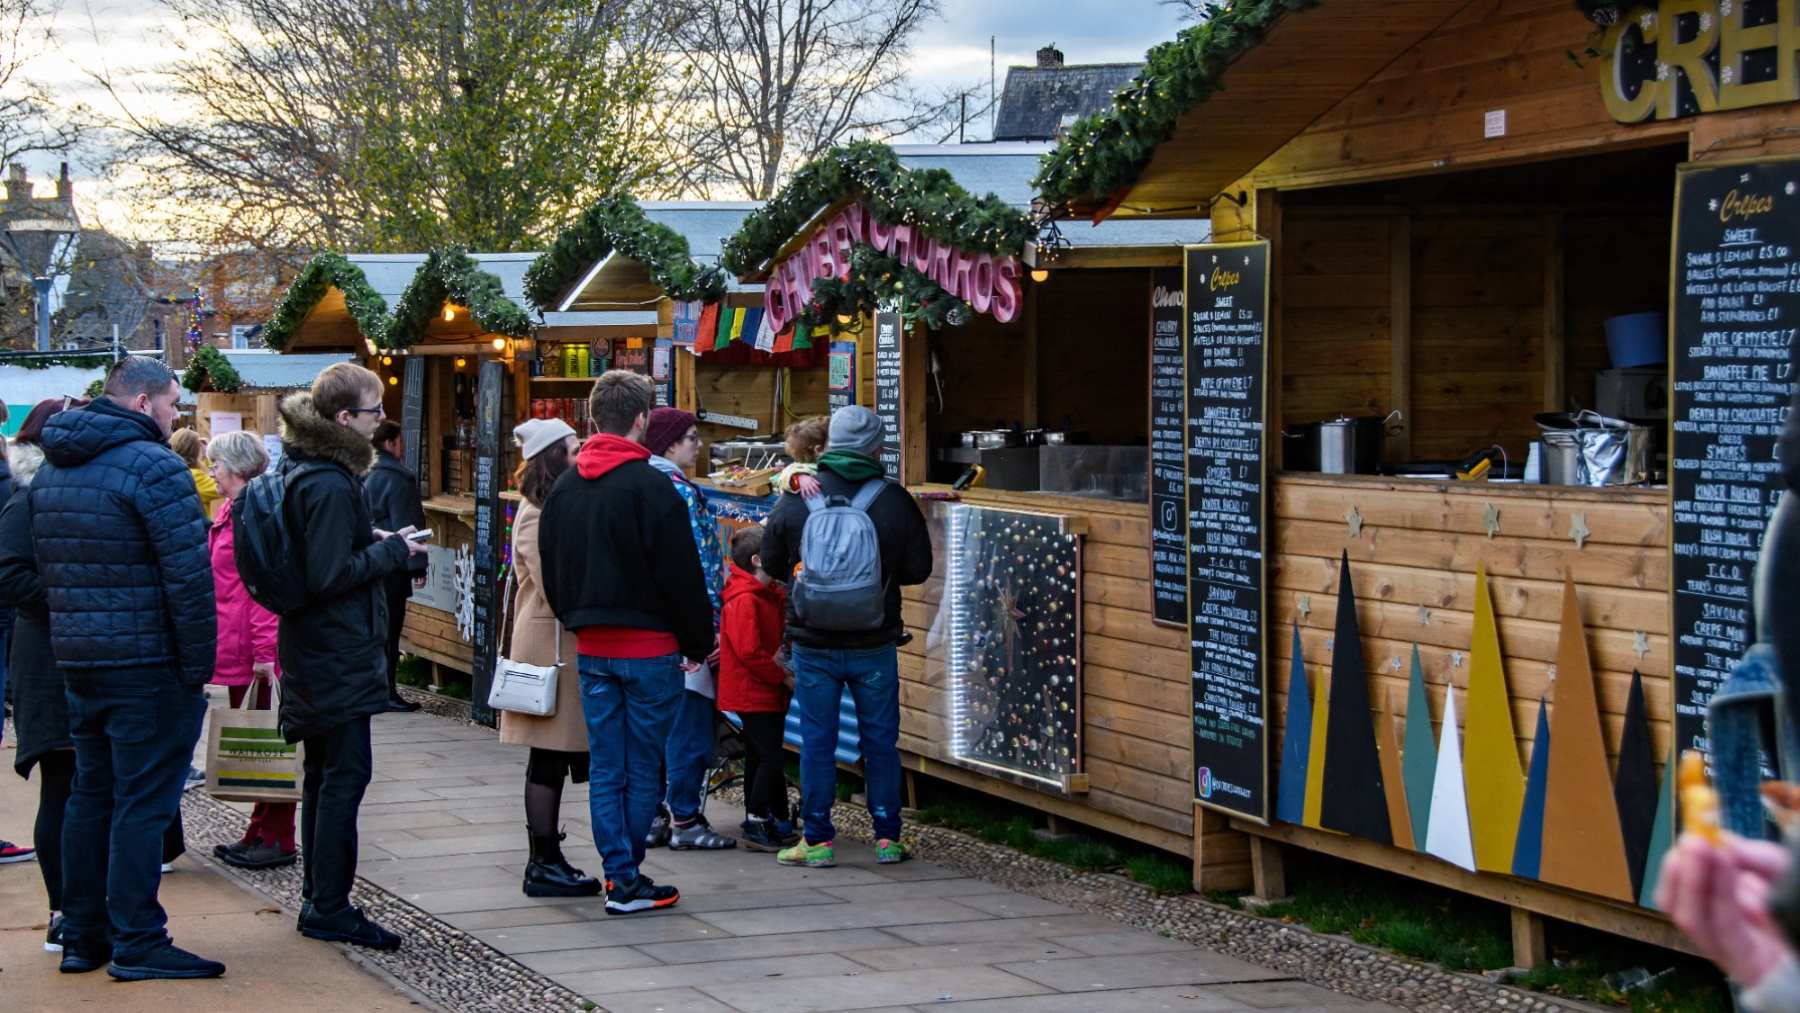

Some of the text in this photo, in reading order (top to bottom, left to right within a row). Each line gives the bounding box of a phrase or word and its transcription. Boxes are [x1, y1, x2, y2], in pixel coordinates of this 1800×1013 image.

[1722, 228, 1757, 242] SWEET
[1724, 249, 1754, 262] LEMON
[1686, 282, 1718, 295] NUTELLA
[1702, 332, 1728, 346] APPLE
[1731, 332, 1743, 346] OF
[1745, 331, 1760, 344] MY
[1760, 331, 1780, 346] EYE
[1704, 365, 1747, 380] BANOFFEE
[1752, 365, 1768, 380] PIE
[1689, 408, 1714, 421] DEATH
[1717, 408, 1730, 422] BY
[1731, 408, 1778, 422] CHOCOLATE
[1695, 484, 1726, 501] KINDER
[1730, 486, 1760, 503] BUENO
